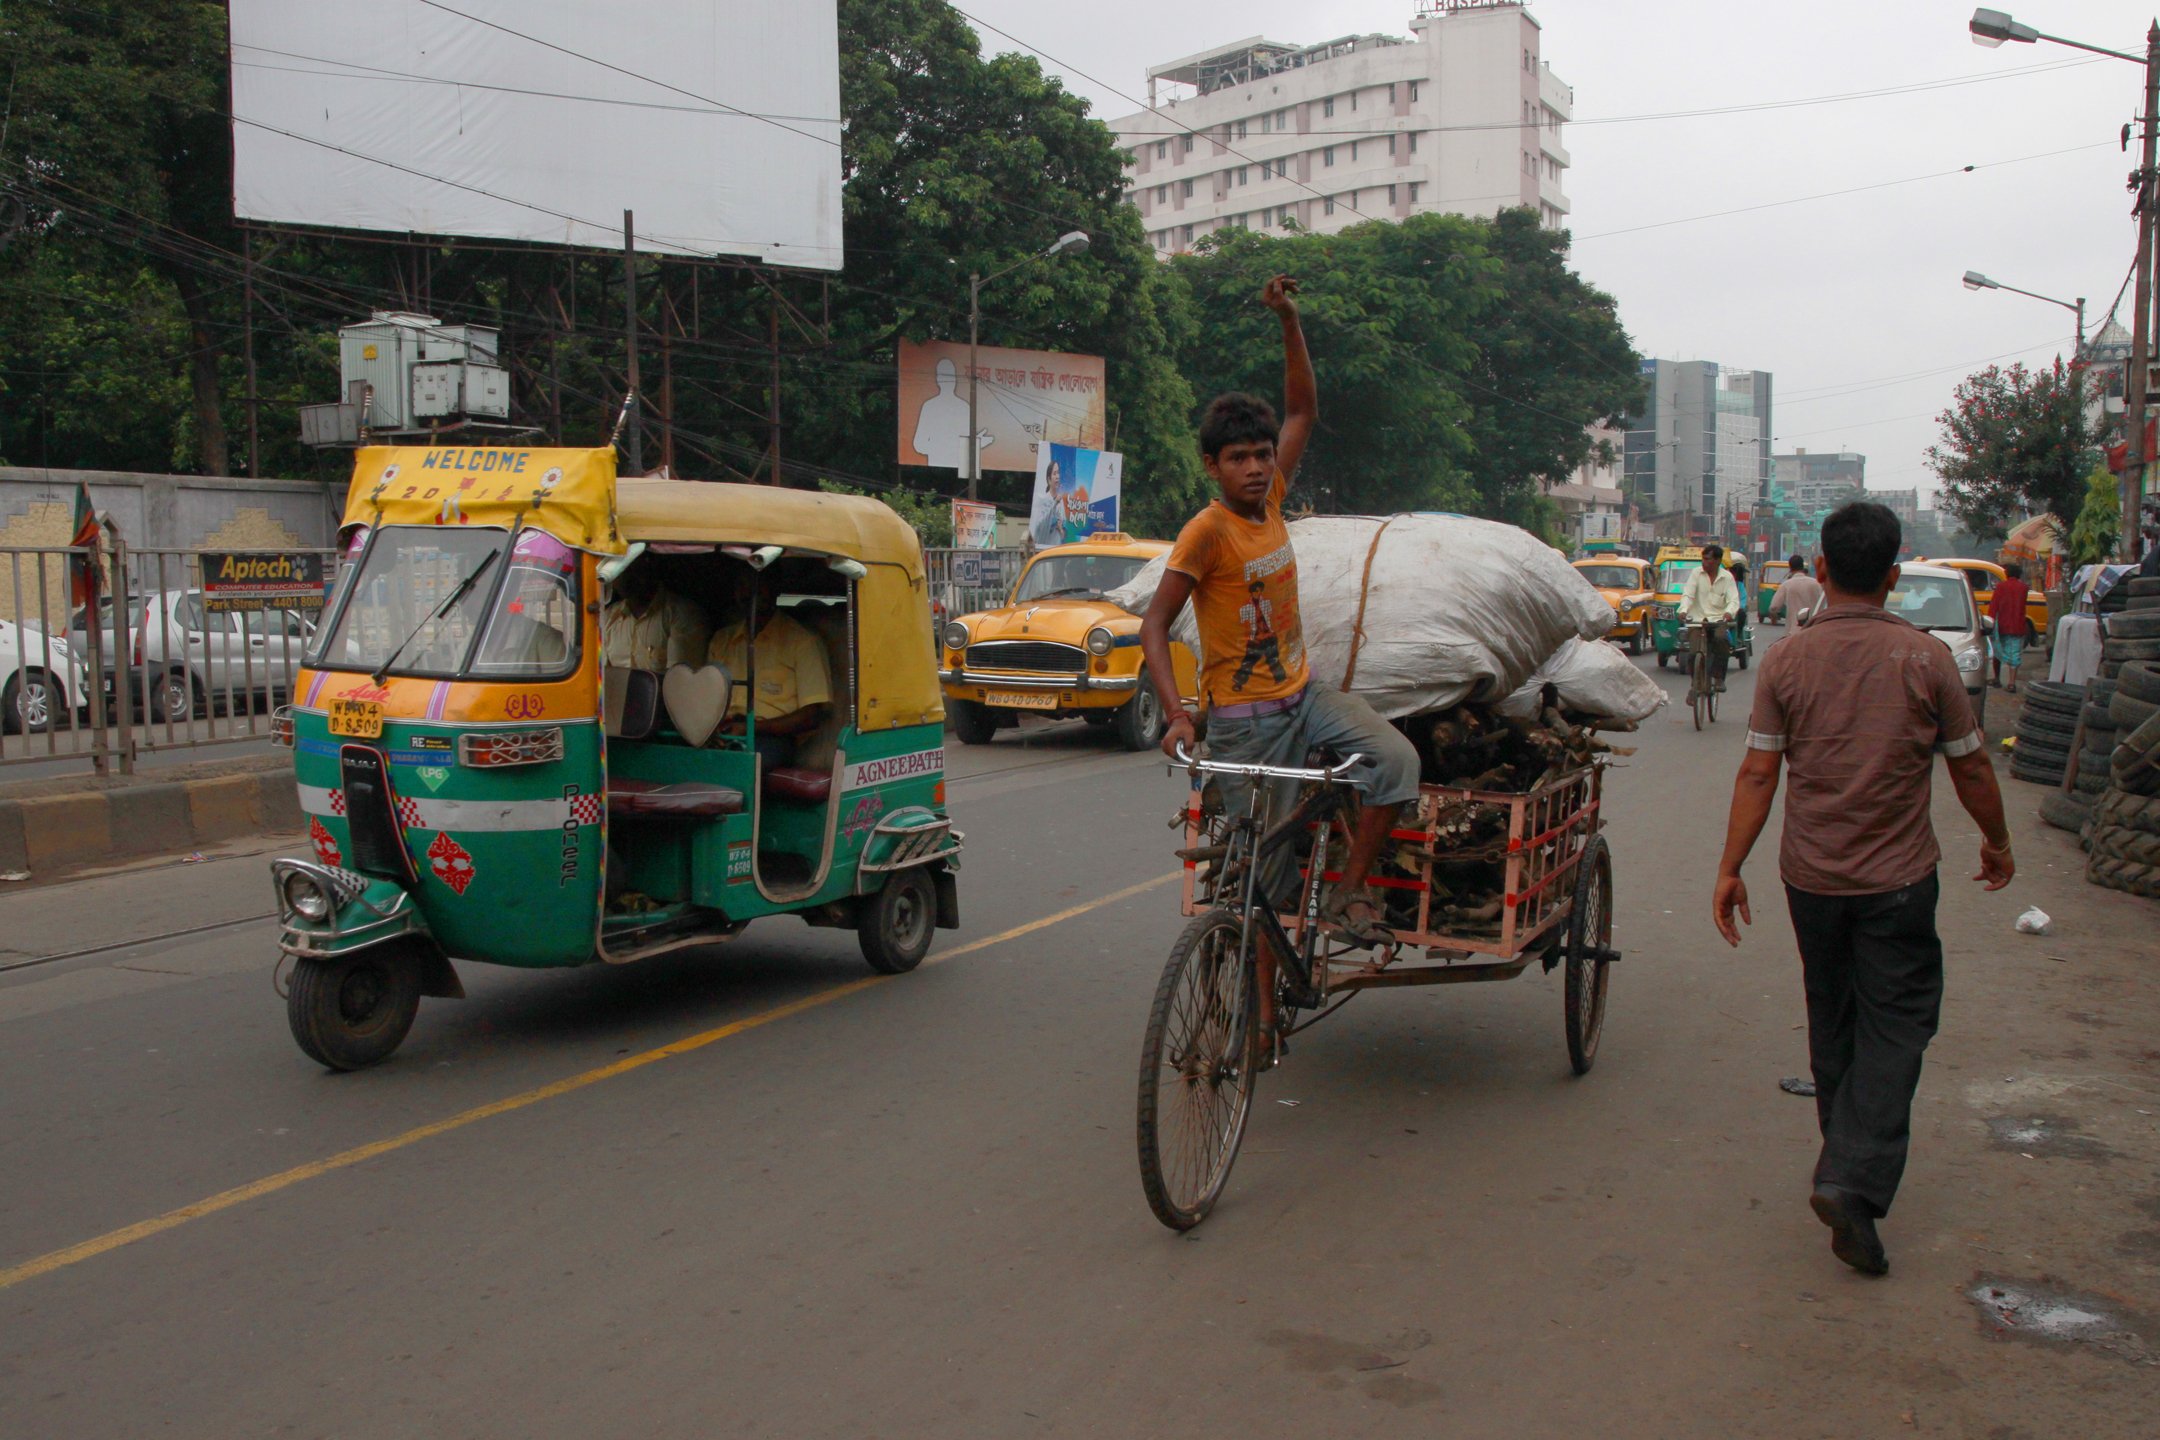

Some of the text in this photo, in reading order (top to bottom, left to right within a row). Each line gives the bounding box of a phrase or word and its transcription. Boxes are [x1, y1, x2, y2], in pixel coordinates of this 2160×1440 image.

[422, 449, 529, 473] WELCOME
[220, 555, 291, 583] Aptech
[206, 599, 230, 610] Park
[233, 598, 264, 609] Street
[273, 597, 298, 608] 4401
[411, 737, 425, 748] RE
[422, 766, 444, 779] LPG
[856, 750, 944, 786] AGNEEPATH
